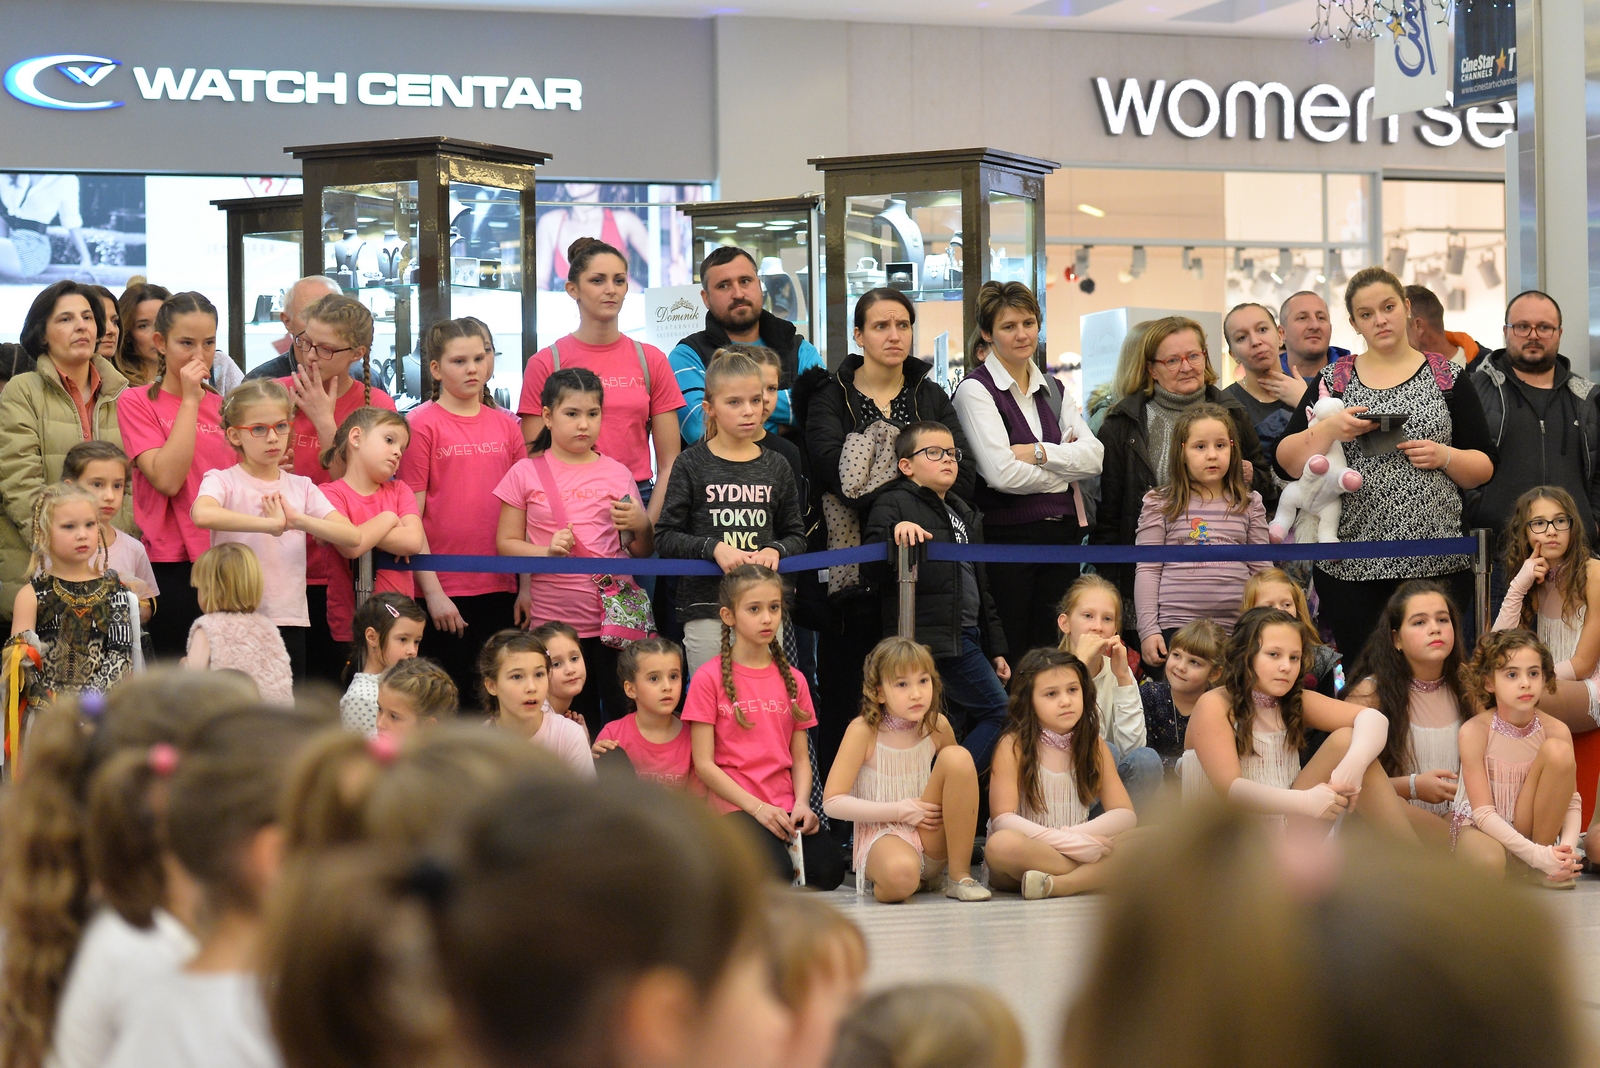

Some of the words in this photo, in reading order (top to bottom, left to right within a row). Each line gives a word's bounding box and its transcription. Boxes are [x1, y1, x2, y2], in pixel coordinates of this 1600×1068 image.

[1461, 54, 1496, 74] CineStar
[1461, 68, 1493, 83] CHANNELS
[132, 67, 348, 105] WATCH
[357, 72, 583, 111] CENTAR
[655, 305, 700, 323] Dominik
[705, 483, 773, 503] SYDNEY
[708, 508, 767, 528] TOKYO
[723, 531, 759, 549] NYC
